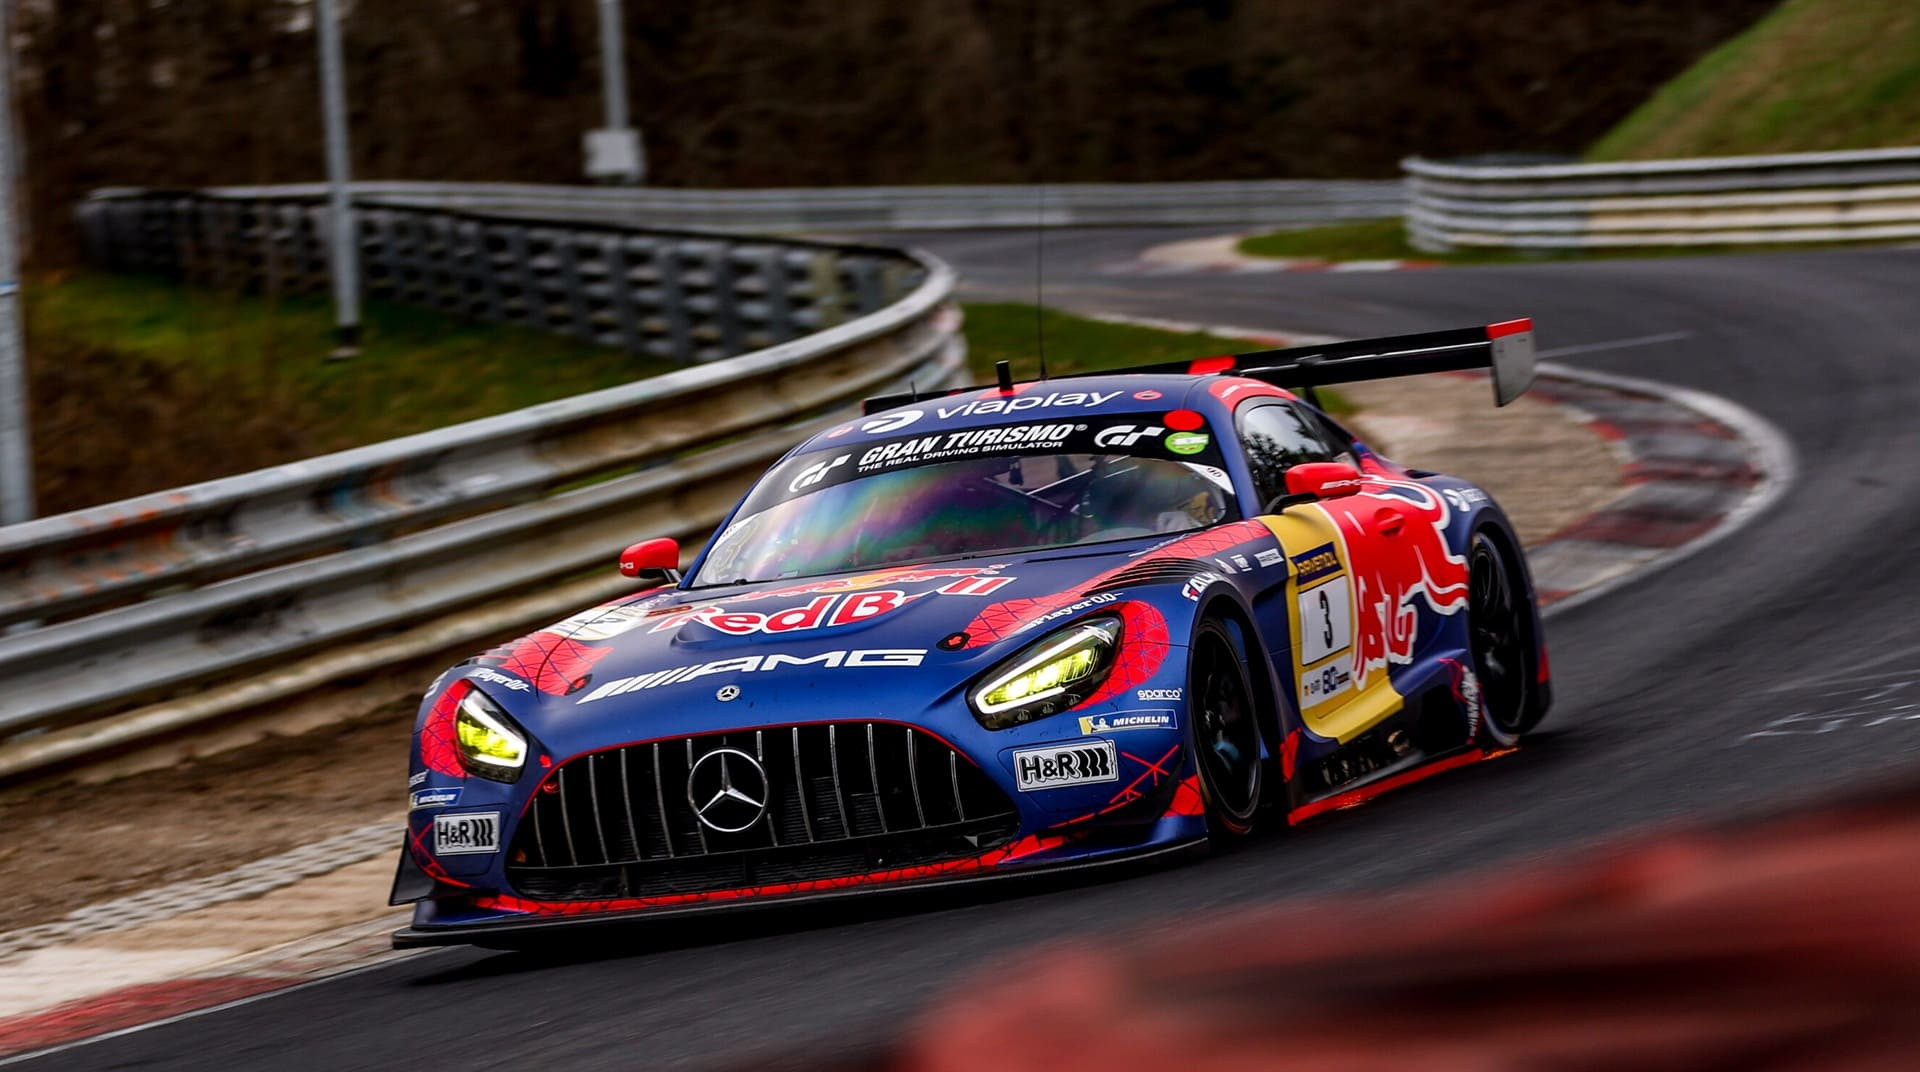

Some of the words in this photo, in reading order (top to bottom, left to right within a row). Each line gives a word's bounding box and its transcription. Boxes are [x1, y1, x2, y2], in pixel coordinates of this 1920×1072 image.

[937, 391, 1125, 419] viaplay
[857, 462, 882, 472] THE
[885, 456, 916, 467] REAL
[922, 447, 979, 460] DRIVING
[981, 441, 1064, 453] SIMULATOR
[858, 435, 943, 466] GRAN
[826, 576, 1017, 627] Bll
[1319, 590, 1334, 650] 3
[676, 649, 928, 683] AMG
[1137, 690, 1181, 700] sparco
[1112, 715, 1170, 728] MICHELIN
[1020, 752, 1077, 782] H&R
[437, 820, 471, 847] H&R
